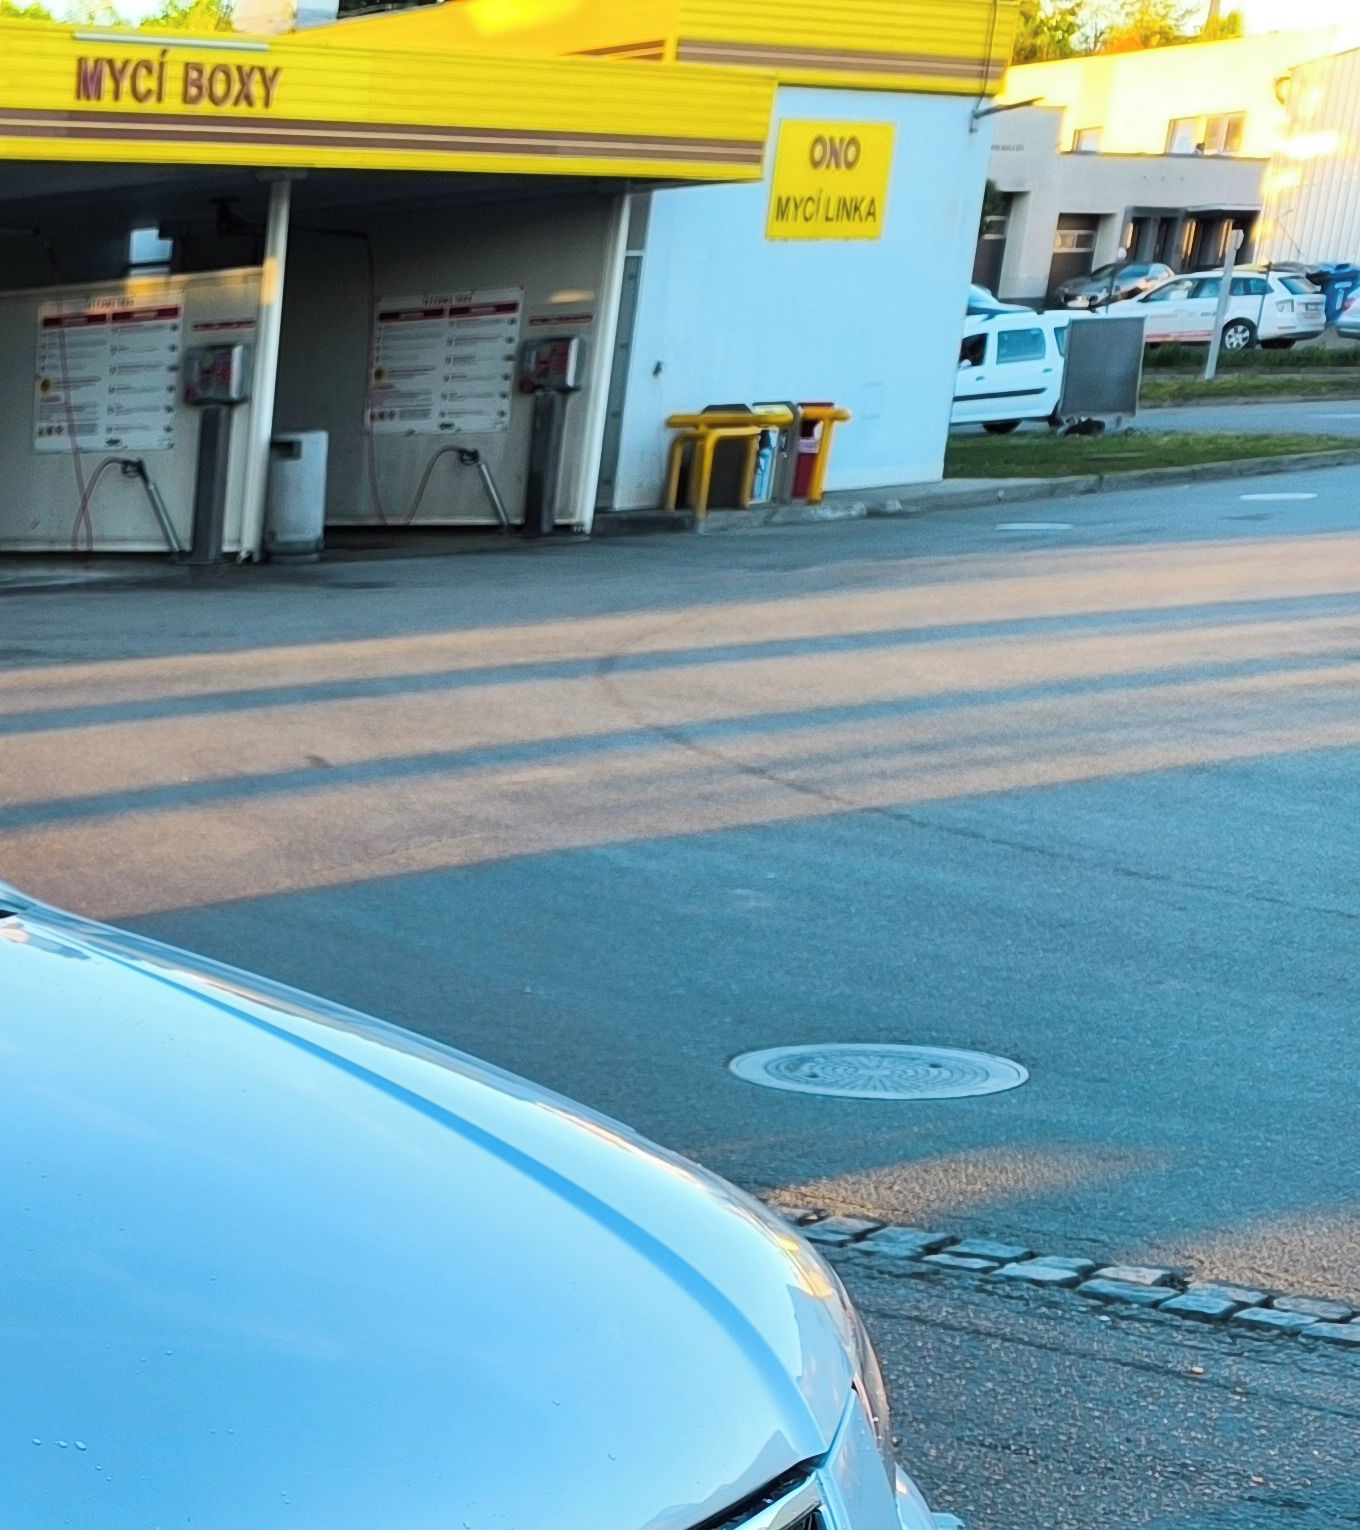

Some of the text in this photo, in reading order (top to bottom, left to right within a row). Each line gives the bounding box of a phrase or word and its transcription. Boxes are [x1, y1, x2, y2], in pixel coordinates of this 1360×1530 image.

[75, 48, 283, 109] MYCÍ BOXY
[808, 134, 861, 170] ONO
[775, 188, 878, 223] MYCÍ LINKA
